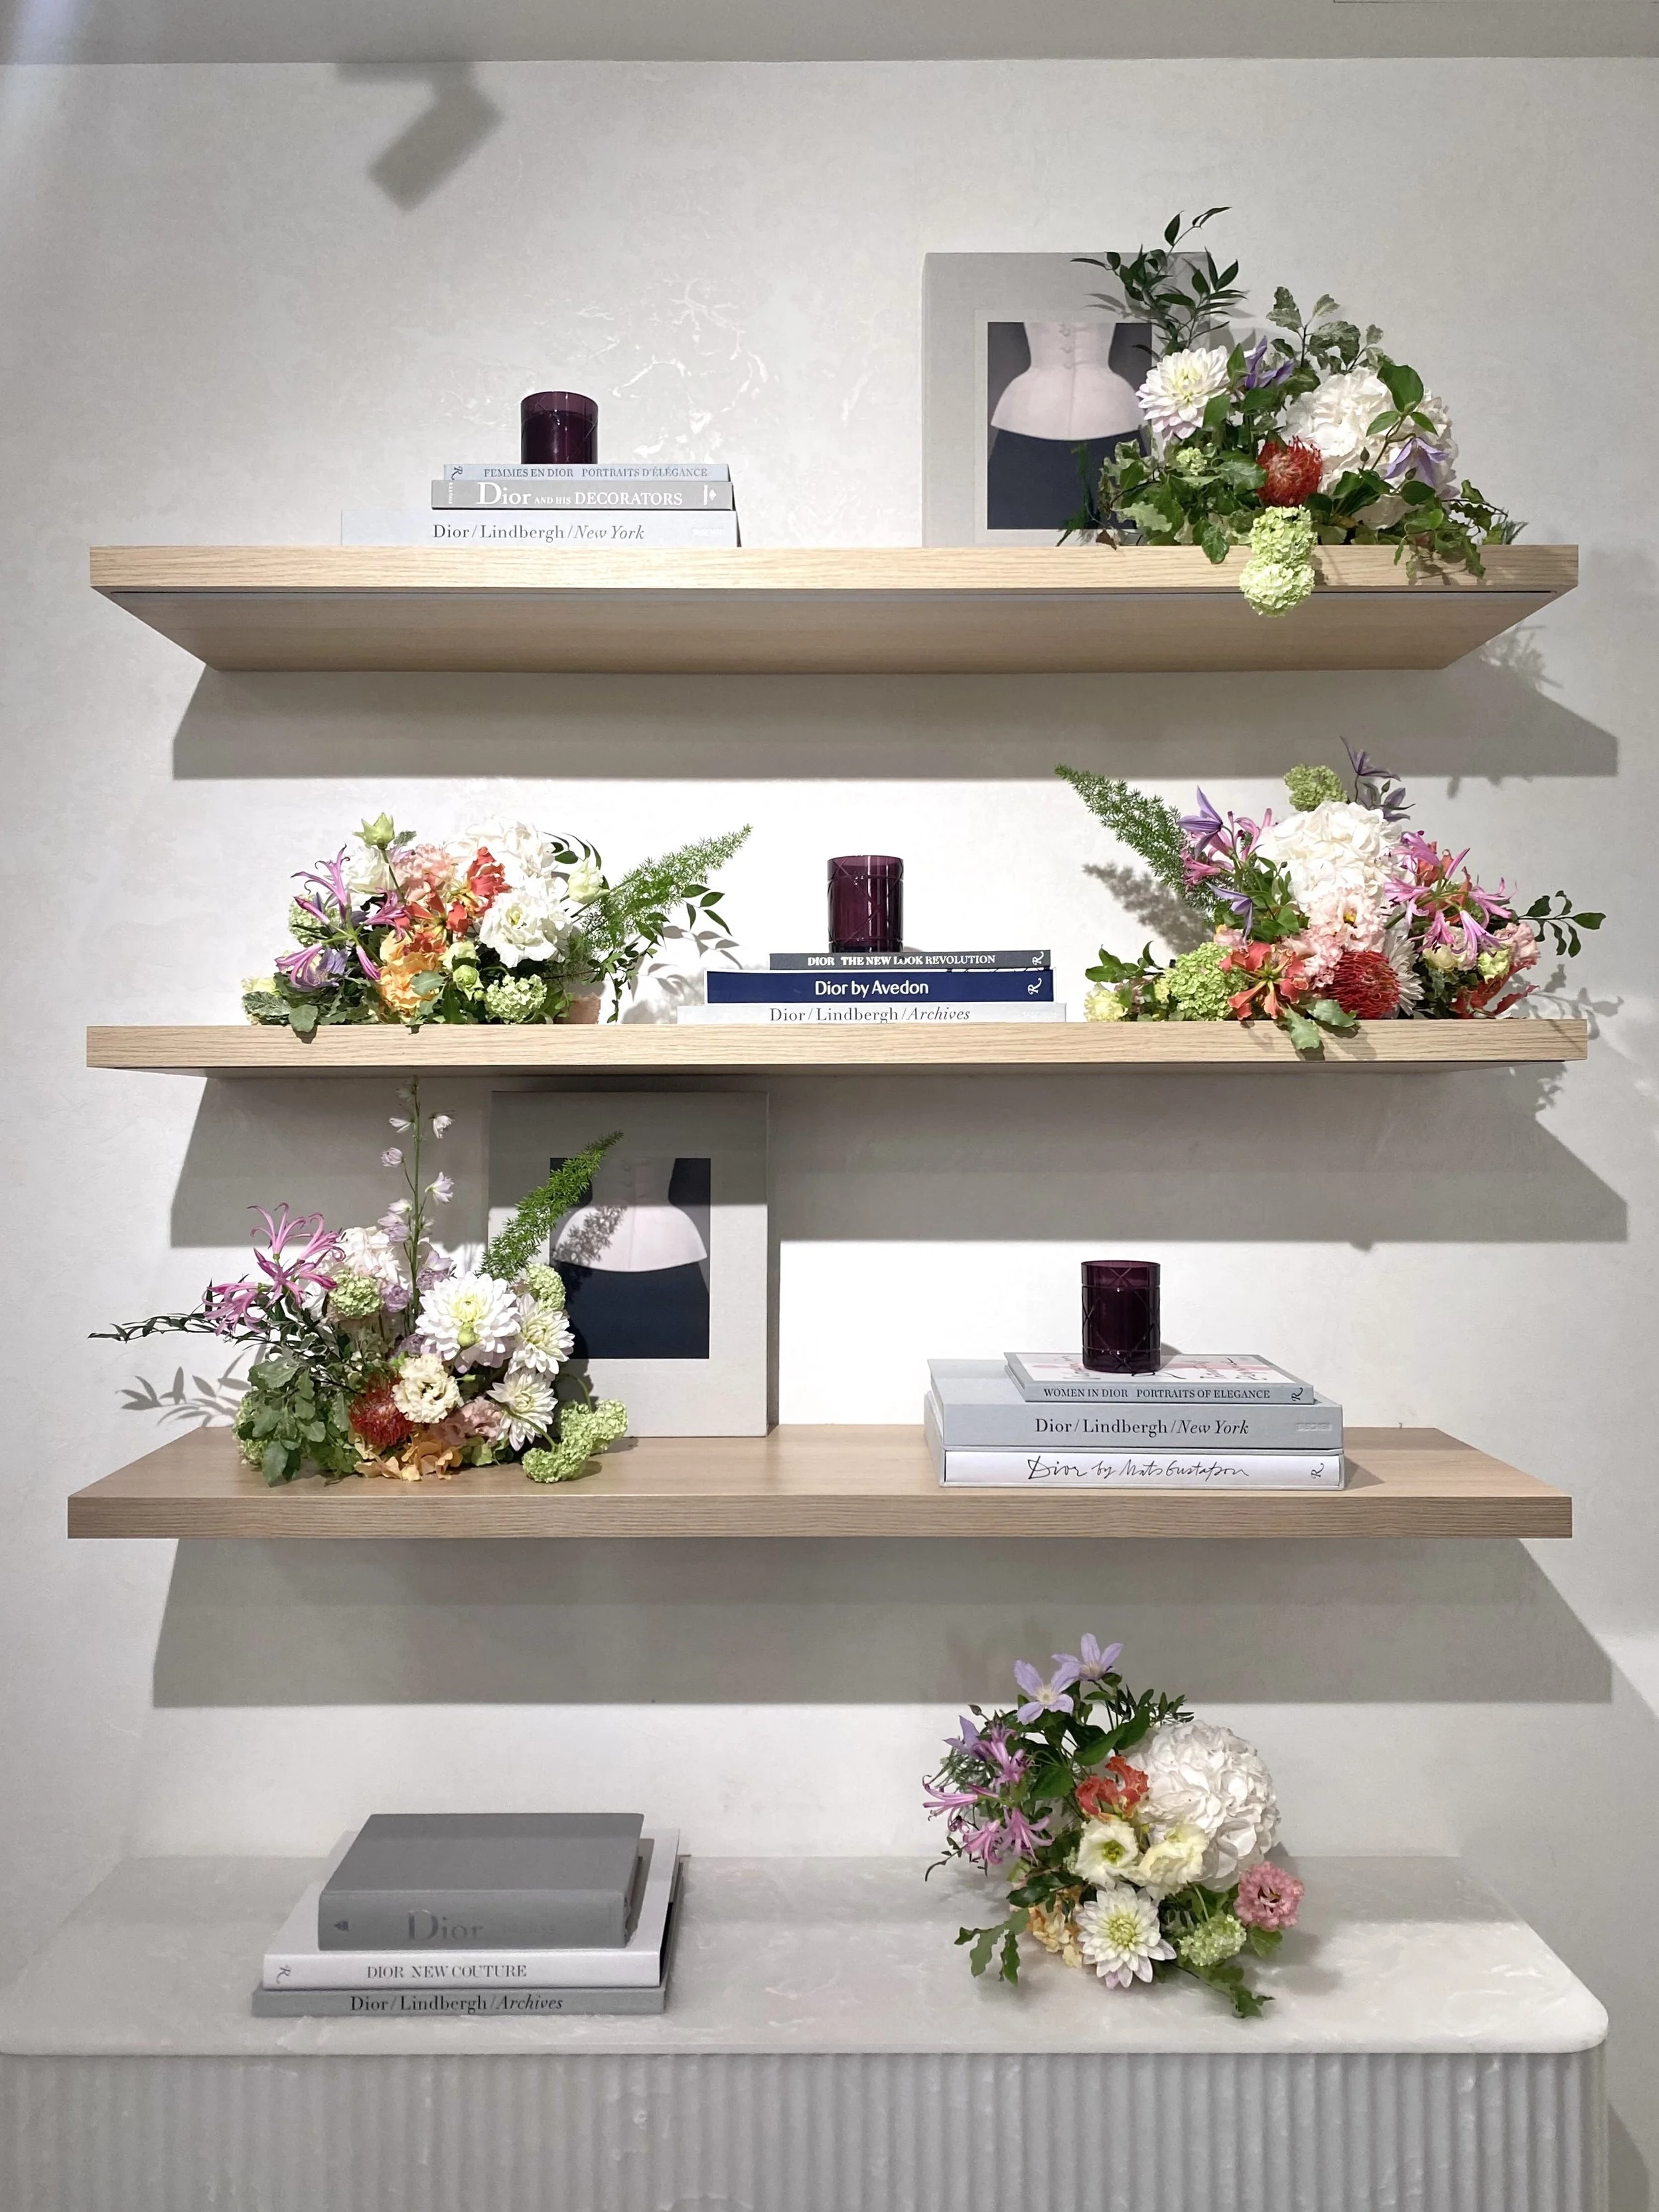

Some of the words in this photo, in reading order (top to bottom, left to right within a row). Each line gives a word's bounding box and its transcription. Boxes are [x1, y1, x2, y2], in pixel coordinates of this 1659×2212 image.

[483, 468, 529, 478] FEMMES
[530, 468, 545, 477] EN
[547, 468, 574, 477] DIOR
[581, 468, 640, 477] PORTRAITS
[642, 466, 707, 477] D'ÉLÉGANCE
[476, 482, 532, 505] Dior
[575, 492, 683, 506] DECORATORS
[611, 524, 644, 540] York
[807, 956, 835, 966] DIOR
[840, 956, 865, 966] THE
[865, 956, 892, 966] NEW
[924, 954, 996, 965] REVOLUTION
[815, 980, 849, 995] Dior
[851, 980, 870, 998] by
[871, 980, 929, 995] Avedon
[1043, 1388, 1085, 1398] WOMEN
[1088, 1388, 1099, 1398] IN
[1102, 1388, 1129, 1398] DIOR
[1136, 1389, 1195, 1398] PORTRAITS
[1196, 1389, 1212, 1398] OF
[1213, 1389, 1271, 1399] ELEGANCE
[1214, 1419, 1249, 1434] York
[1028, 1455, 1087, 1479] Dior
[1091, 1461, 1116, 1478] by
[405, 1909, 484, 1943] Dior
[367, 1966, 404, 1978] DIOR
[411, 1965, 449, 1978] NEW
[451, 1964, 528, 1978] COUTURE
